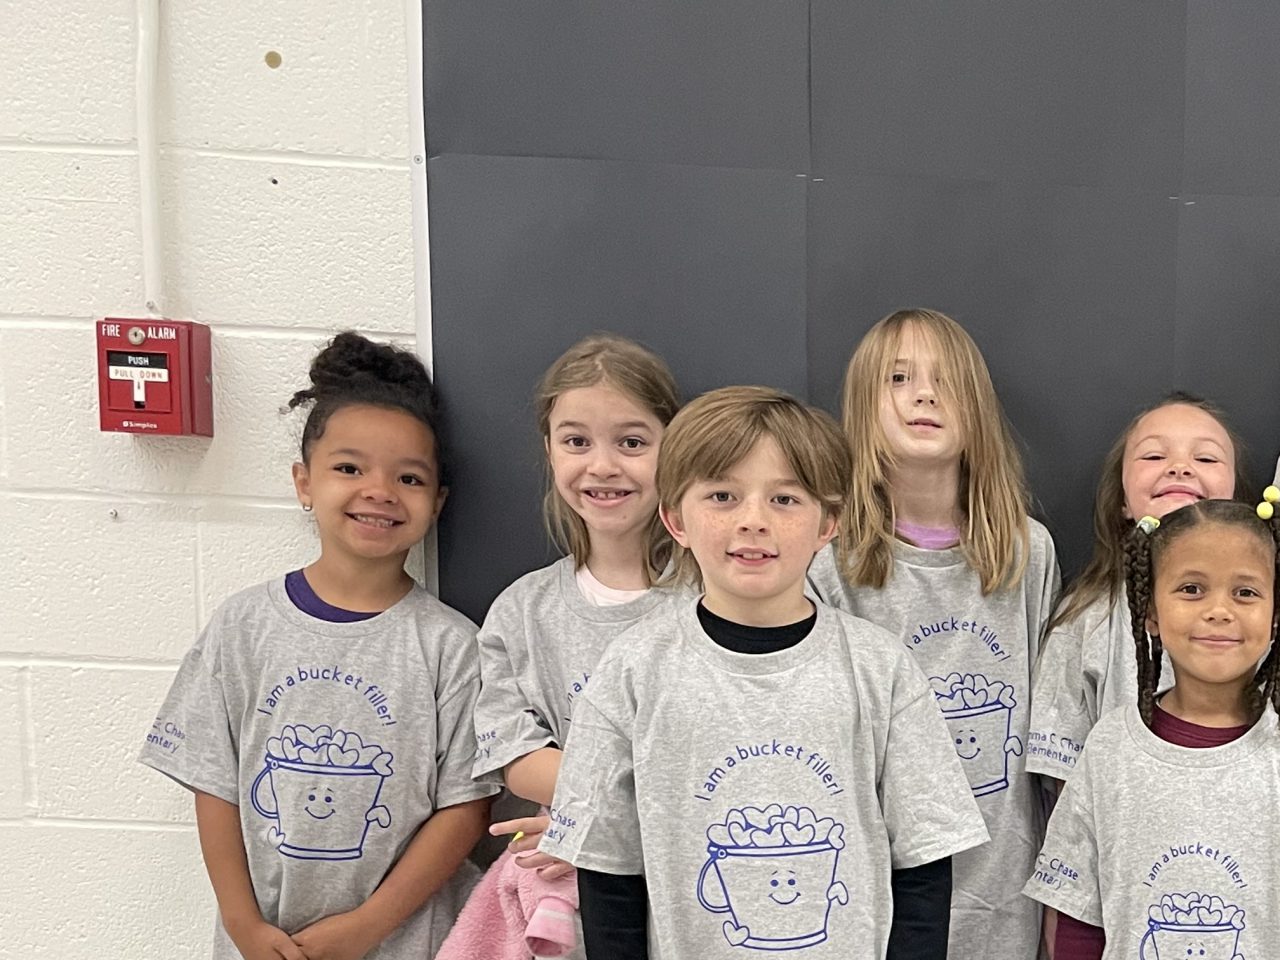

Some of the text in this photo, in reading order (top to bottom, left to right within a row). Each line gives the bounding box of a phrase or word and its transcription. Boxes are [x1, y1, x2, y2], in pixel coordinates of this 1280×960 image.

[102, 324, 176, 339] FIRE ALARM
[128, 355, 149, 365] PUSH
[114, 368, 162, 378] PULL DOWN
[912, 616, 1011, 662] a bucket filler!
[257, 665, 397, 726] I am a bucket filler!
[704, 767, 726, 792] am
[725, 756, 736, 767] a
[736, 739, 803, 760] bucket
[805, 753, 844, 796] filler!
[551, 808, 577, 829] Chase
[1050, 858, 1078, 880] Chase
[1148, 862, 1162, 881] am
[1162, 854, 1169, 863] a
[1170, 842, 1219, 860] bucket
[1221, 855, 1248, 889] filler!
